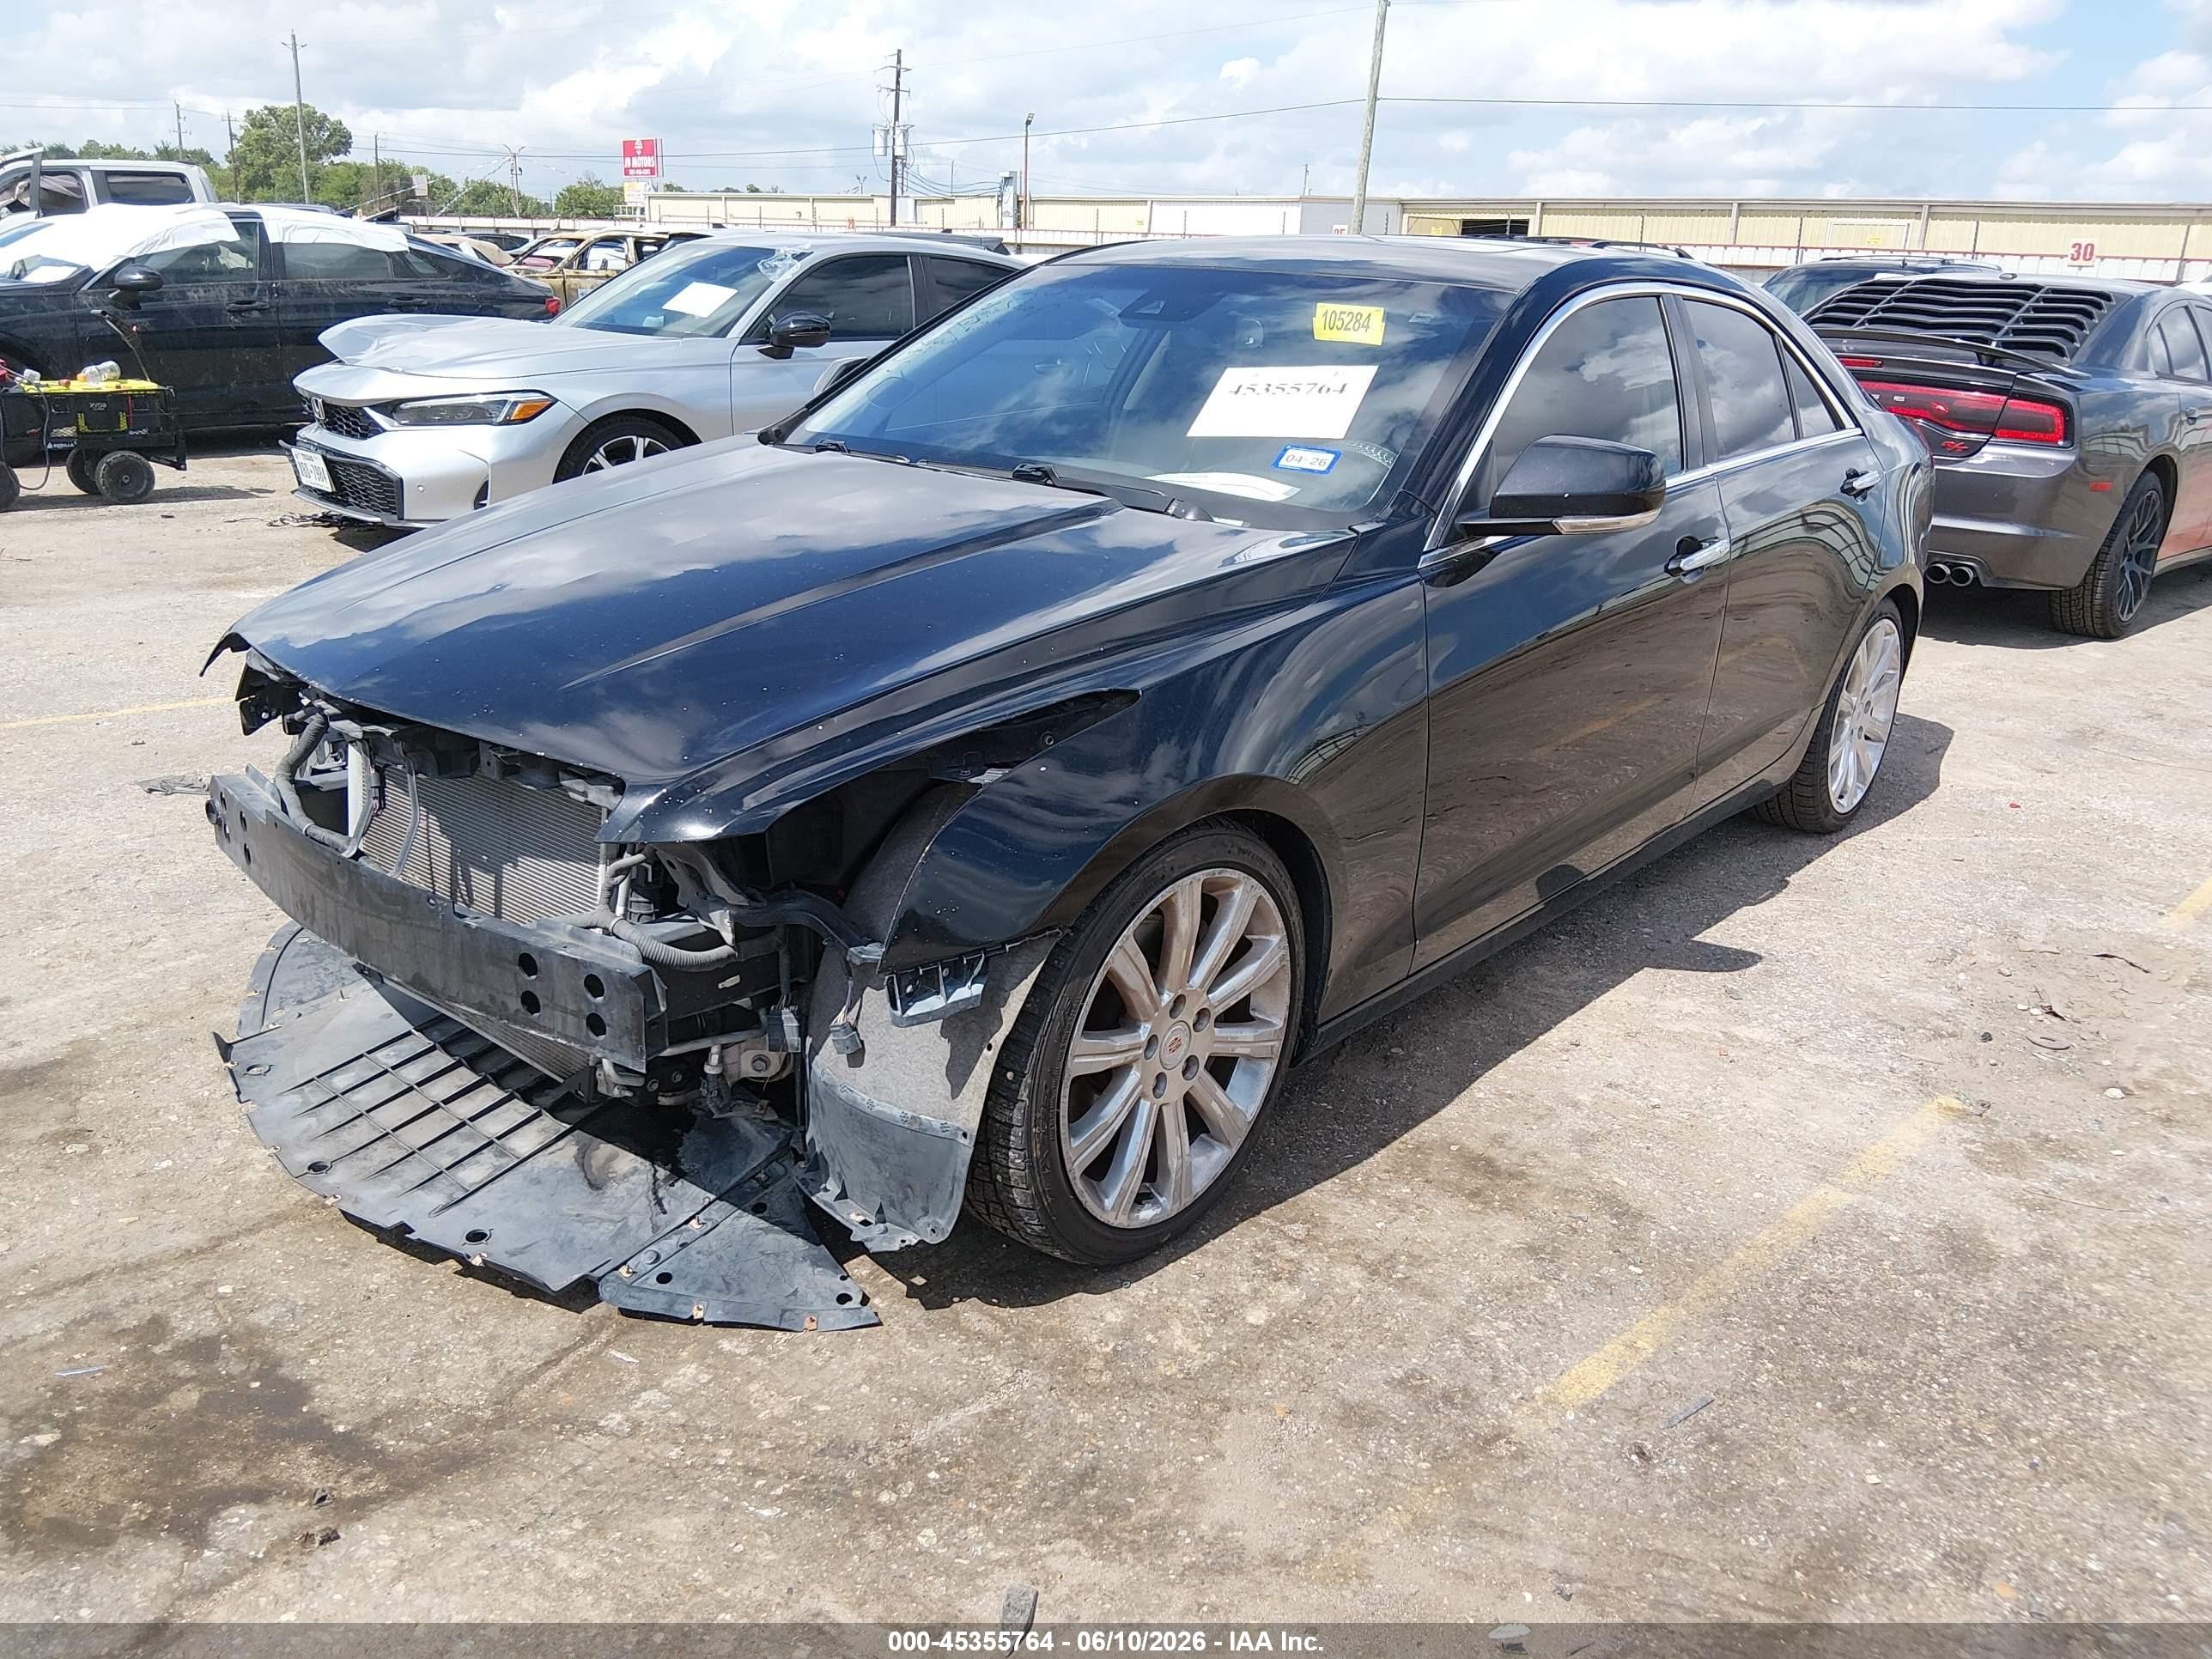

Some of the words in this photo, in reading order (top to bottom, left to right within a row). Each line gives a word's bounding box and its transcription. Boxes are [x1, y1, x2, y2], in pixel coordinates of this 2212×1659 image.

[631, 155, 655, 168] MOTORS
[2069, 242, 2095, 262] 30
[1322, 308, 1372, 333] 105284
[1229, 382, 1348, 396] 45355764
